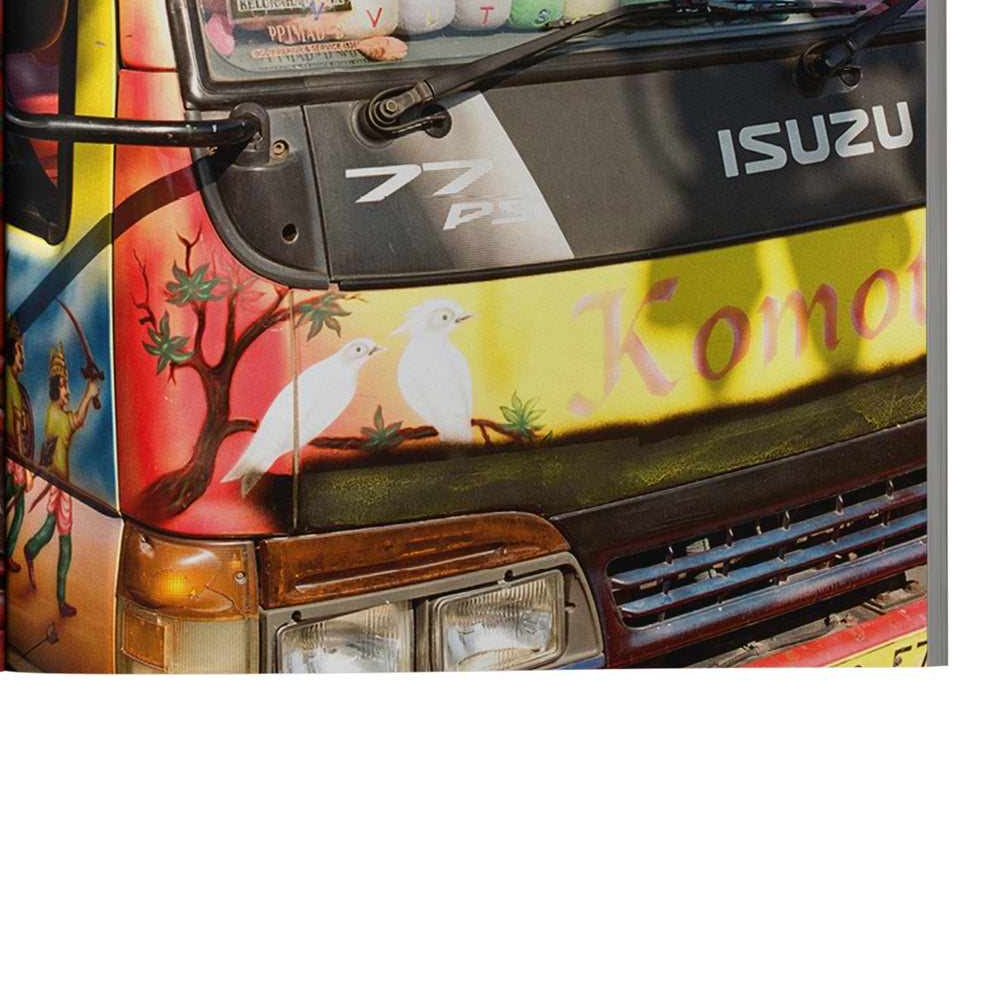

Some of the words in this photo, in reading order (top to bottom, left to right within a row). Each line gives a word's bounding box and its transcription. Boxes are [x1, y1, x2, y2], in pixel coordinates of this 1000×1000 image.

[366, 7, 383, 28] V
[480, 6, 495, 25] T
[717, 101, 914, 178] ISUZU
[345, 159, 493, 204] 77
[443, 201, 530, 231] PS
